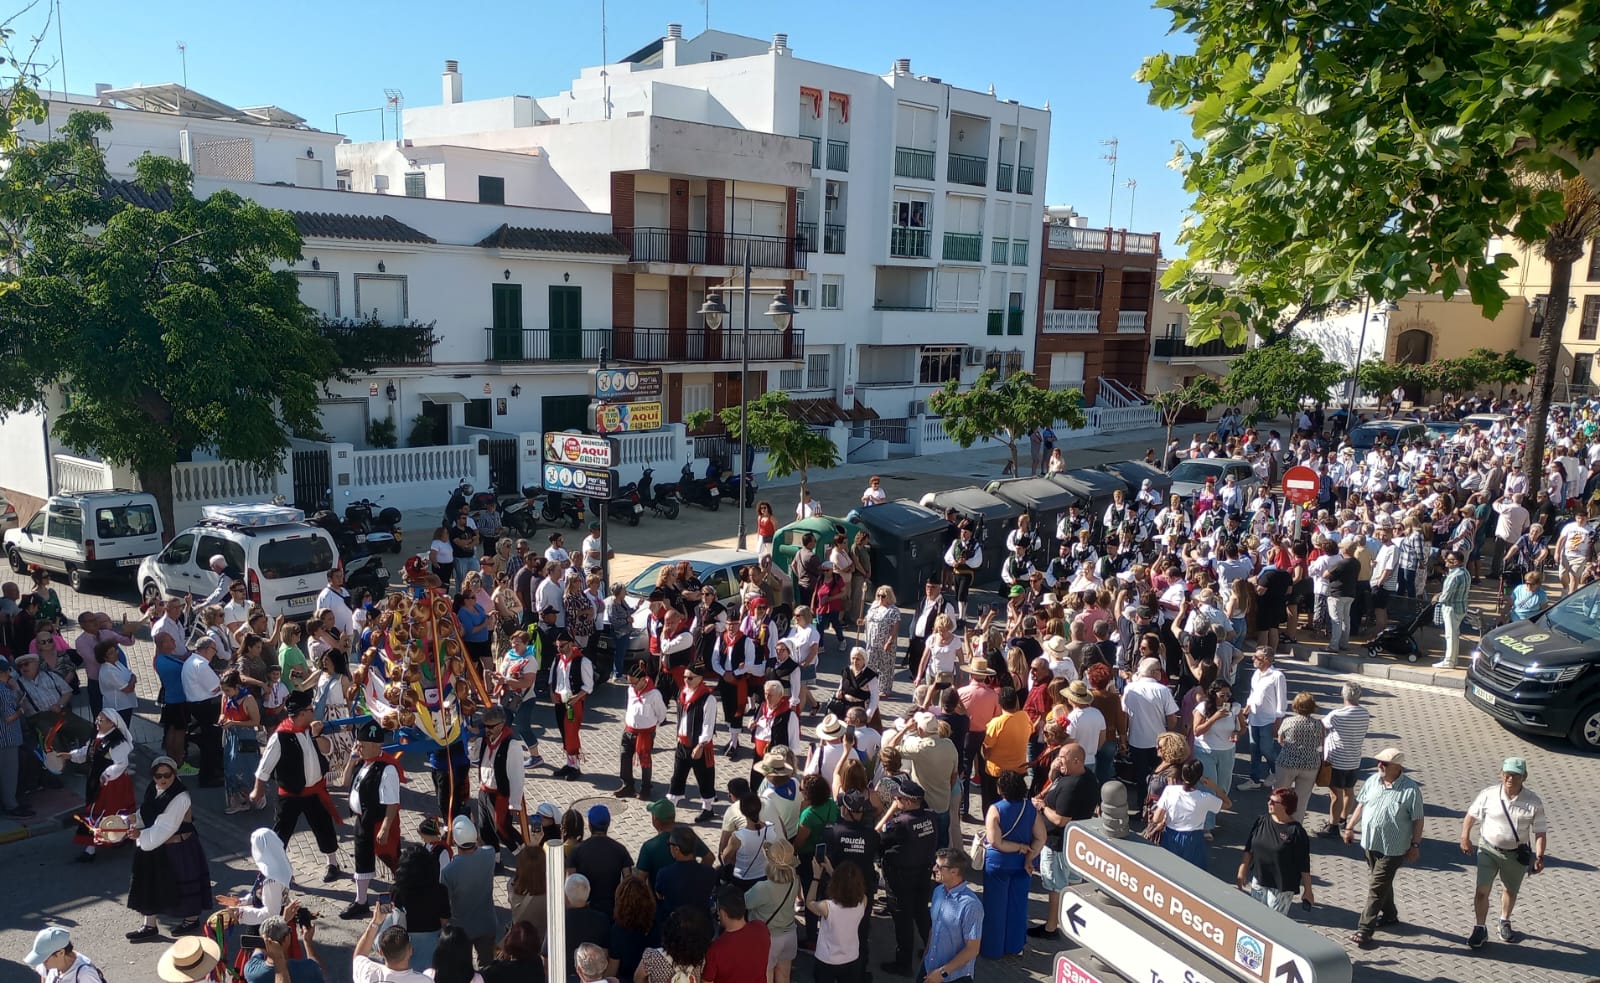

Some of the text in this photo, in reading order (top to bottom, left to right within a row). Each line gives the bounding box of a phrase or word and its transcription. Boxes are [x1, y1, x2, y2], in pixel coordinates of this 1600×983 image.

[632, 411, 659, 421] AQUÍ
[581, 447, 608, 457] AQUÍ
[1494, 635, 1534, 655] POLICÍA
[840, 836, 865, 845] POLICÍA
[1074, 840, 1225, 946] Corrales de Pesca
